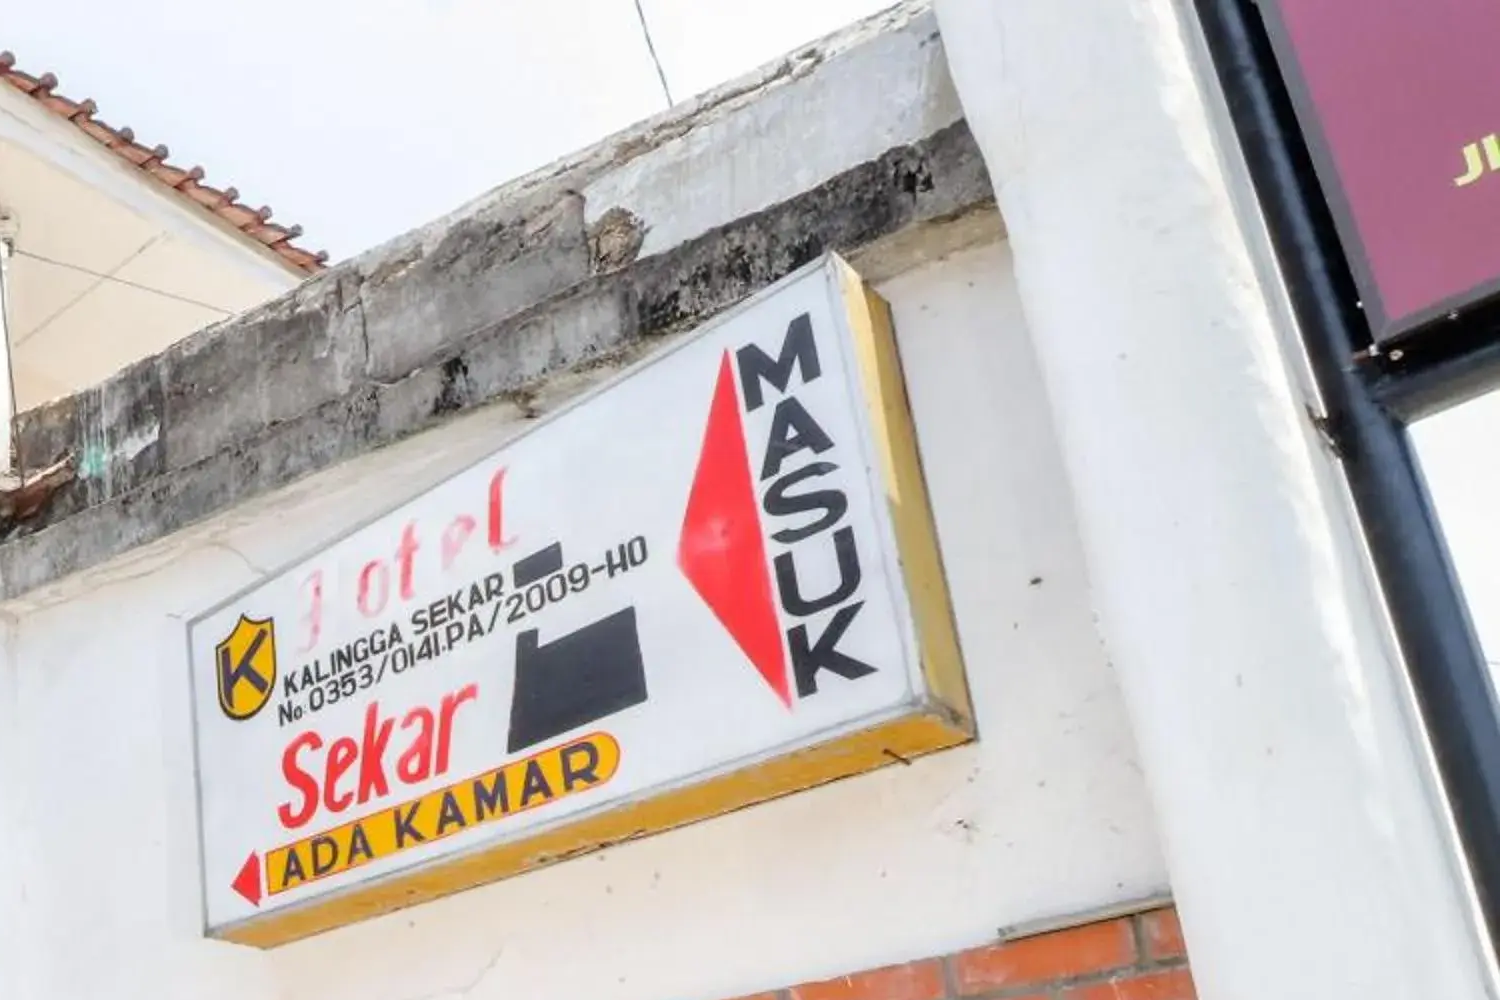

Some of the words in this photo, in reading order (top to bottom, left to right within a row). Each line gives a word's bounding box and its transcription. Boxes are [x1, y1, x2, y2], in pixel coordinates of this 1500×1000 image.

[736, 312, 879, 698] MASUK
[221, 628, 269, 708] K
[283, 622, 404, 698] KALINGGA
[411, 572, 505, 636] SEKAR
[277, 682, 479, 830] Sekar
[281, 823, 374, 887] ADA
[393, 741, 600, 849] KAMAR
